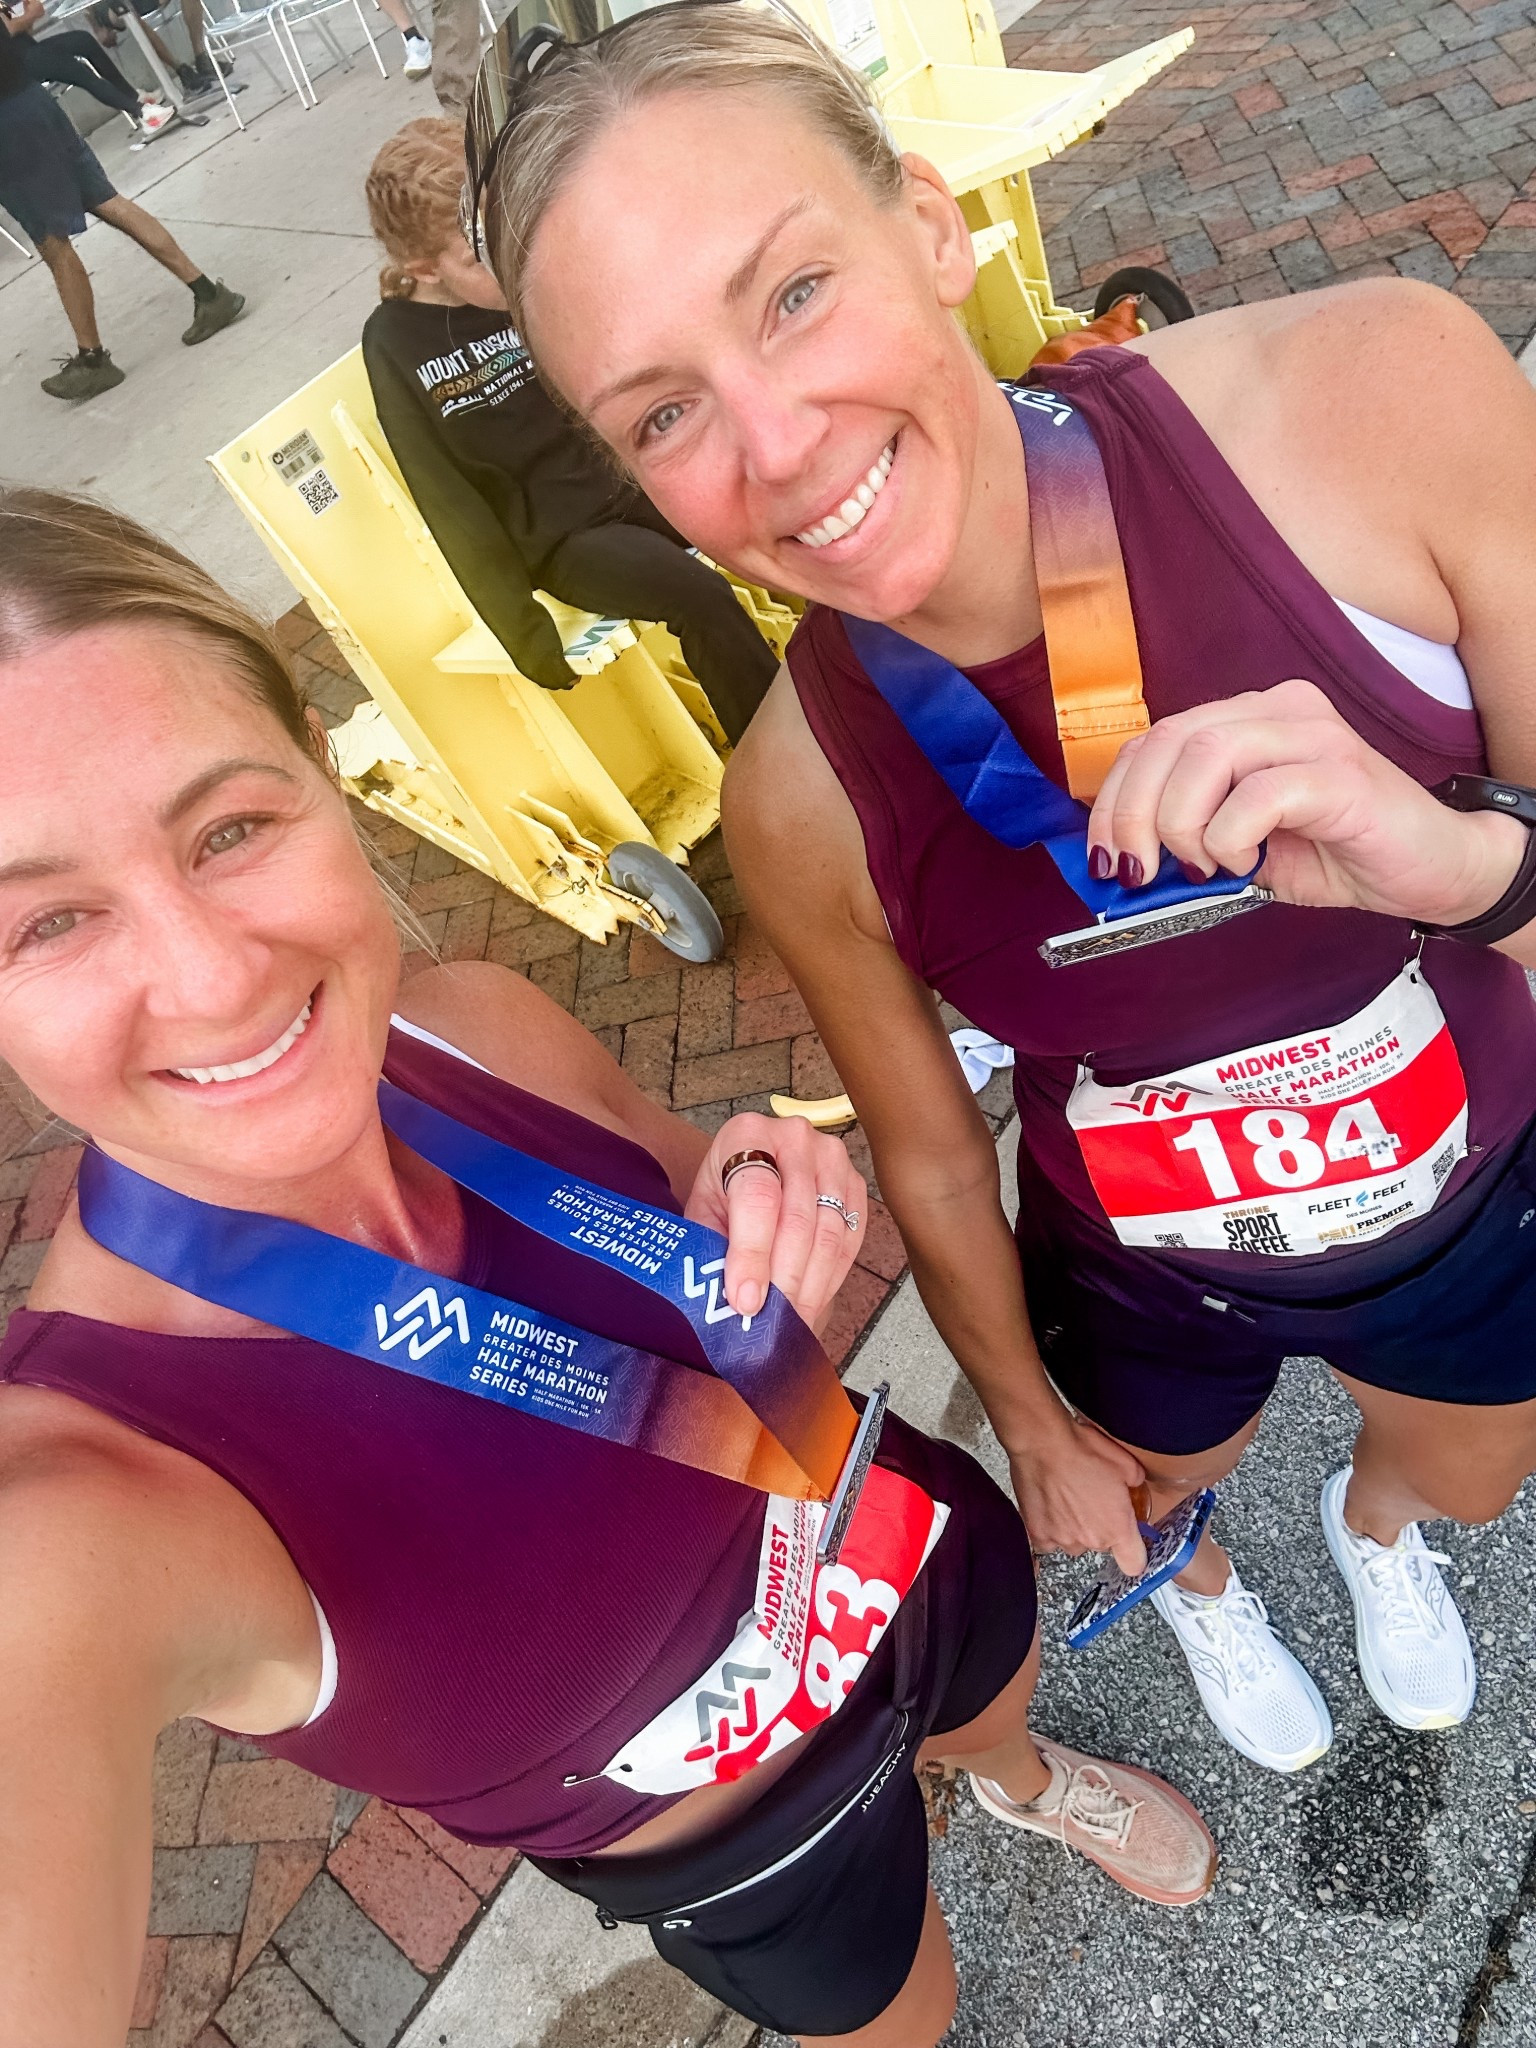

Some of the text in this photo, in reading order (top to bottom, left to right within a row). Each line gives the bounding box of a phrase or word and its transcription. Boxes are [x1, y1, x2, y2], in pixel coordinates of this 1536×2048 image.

[416, 327, 522, 392] MOUNT RUSHM
[483, 365, 524, 395] NATIONAL
[489, 379, 525, 407] SINCE 1941
[1496, 793, 1514, 802] RUN
[1216, 1036, 1332, 1083] MIDWEST
[1225, 1026, 1392, 1093] GREATER DES MOINES
[1231, 1036, 1400, 1101] HALF MARATHON
[1318, 1085, 1335, 1095] HALF
[1336, 1071, 1372, 1088] MARATHON
[1379, 1061, 1391, 1070] 10K
[1320, 1065, 1396, 1100] KIDS ONE MILE FUN RUN
[1238, 1094, 1312, 1105] SERIES
[1172, 1097, 1402, 1200] 184
[552, 1189, 679, 1251] HALF MARATHON
[1223, 1205, 1270, 1219] THRONE
[1308, 1179, 1407, 1215] FLEET FEET
[1346, 1204, 1383, 1219] DES MOINES
[1356, 1200, 1414, 1230] PREMIER
[547, 1198, 671, 1260] GREATER DES MOINES
[632, 1210, 688, 1238] SERIES
[1223, 1212, 1282, 1242] SPORT
[570, 1226, 662, 1275] MIDWEST
[490, 1311, 578, 1357] MIDWEST
[469, 1365, 528, 1397] SERIES
[477, 1346, 607, 1404] HALF MARATHON
[483, 1333, 609, 1386] GREATER DES MOINES
[533, 1388, 548, 1396] HALF
[548, 1392, 575, 1406] MARATHON
[757, 1524, 789, 1640] MIDWEST
[774, 1500, 801, 1650] GREATER DES MOIN
[781, 1604, 796, 1660] HALF
[792, 1593, 807, 1671] SERIES
[861, 1743, 906, 1813] JUEACHY
